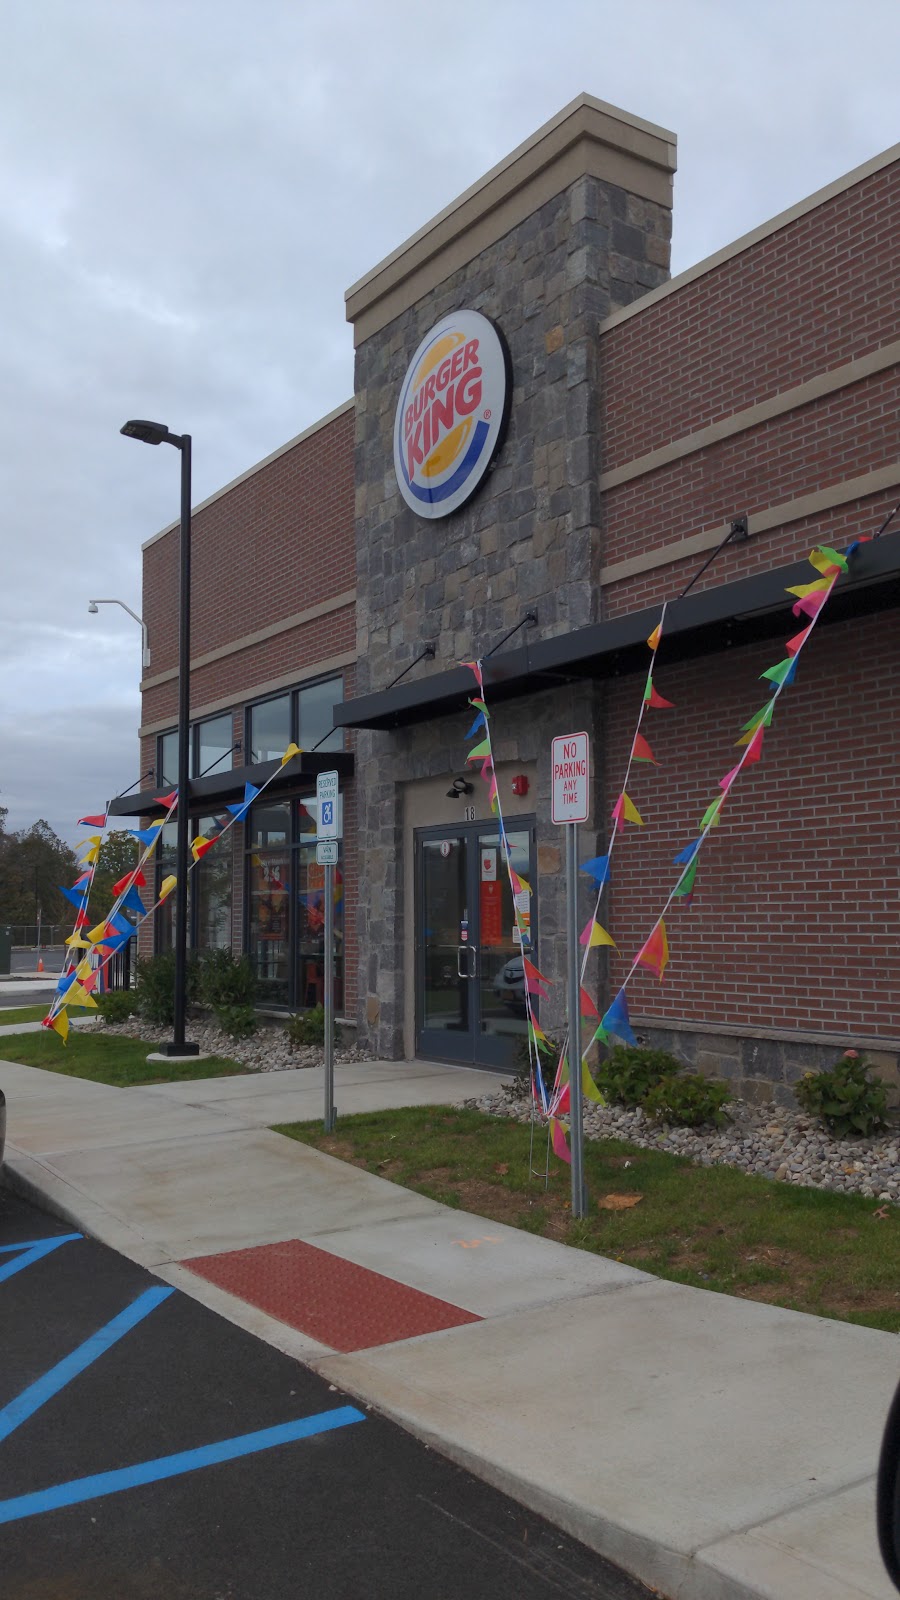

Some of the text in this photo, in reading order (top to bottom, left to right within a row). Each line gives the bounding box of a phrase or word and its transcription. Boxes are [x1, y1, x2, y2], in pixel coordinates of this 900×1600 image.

[405, 338, 479, 441] BURGER
[407, 366, 482, 485] KING
[563, 742, 577, 759] NO
[555, 760, 586, 779] PARKING
[318, 777, 336, 788] RESERVED
[563, 780, 577, 791] ANY
[319, 789, 336, 800] PARKING
[563, 792, 578, 804] TIME
[465, 806, 475, 820] 18
[322, 845, 332, 853] VAN
